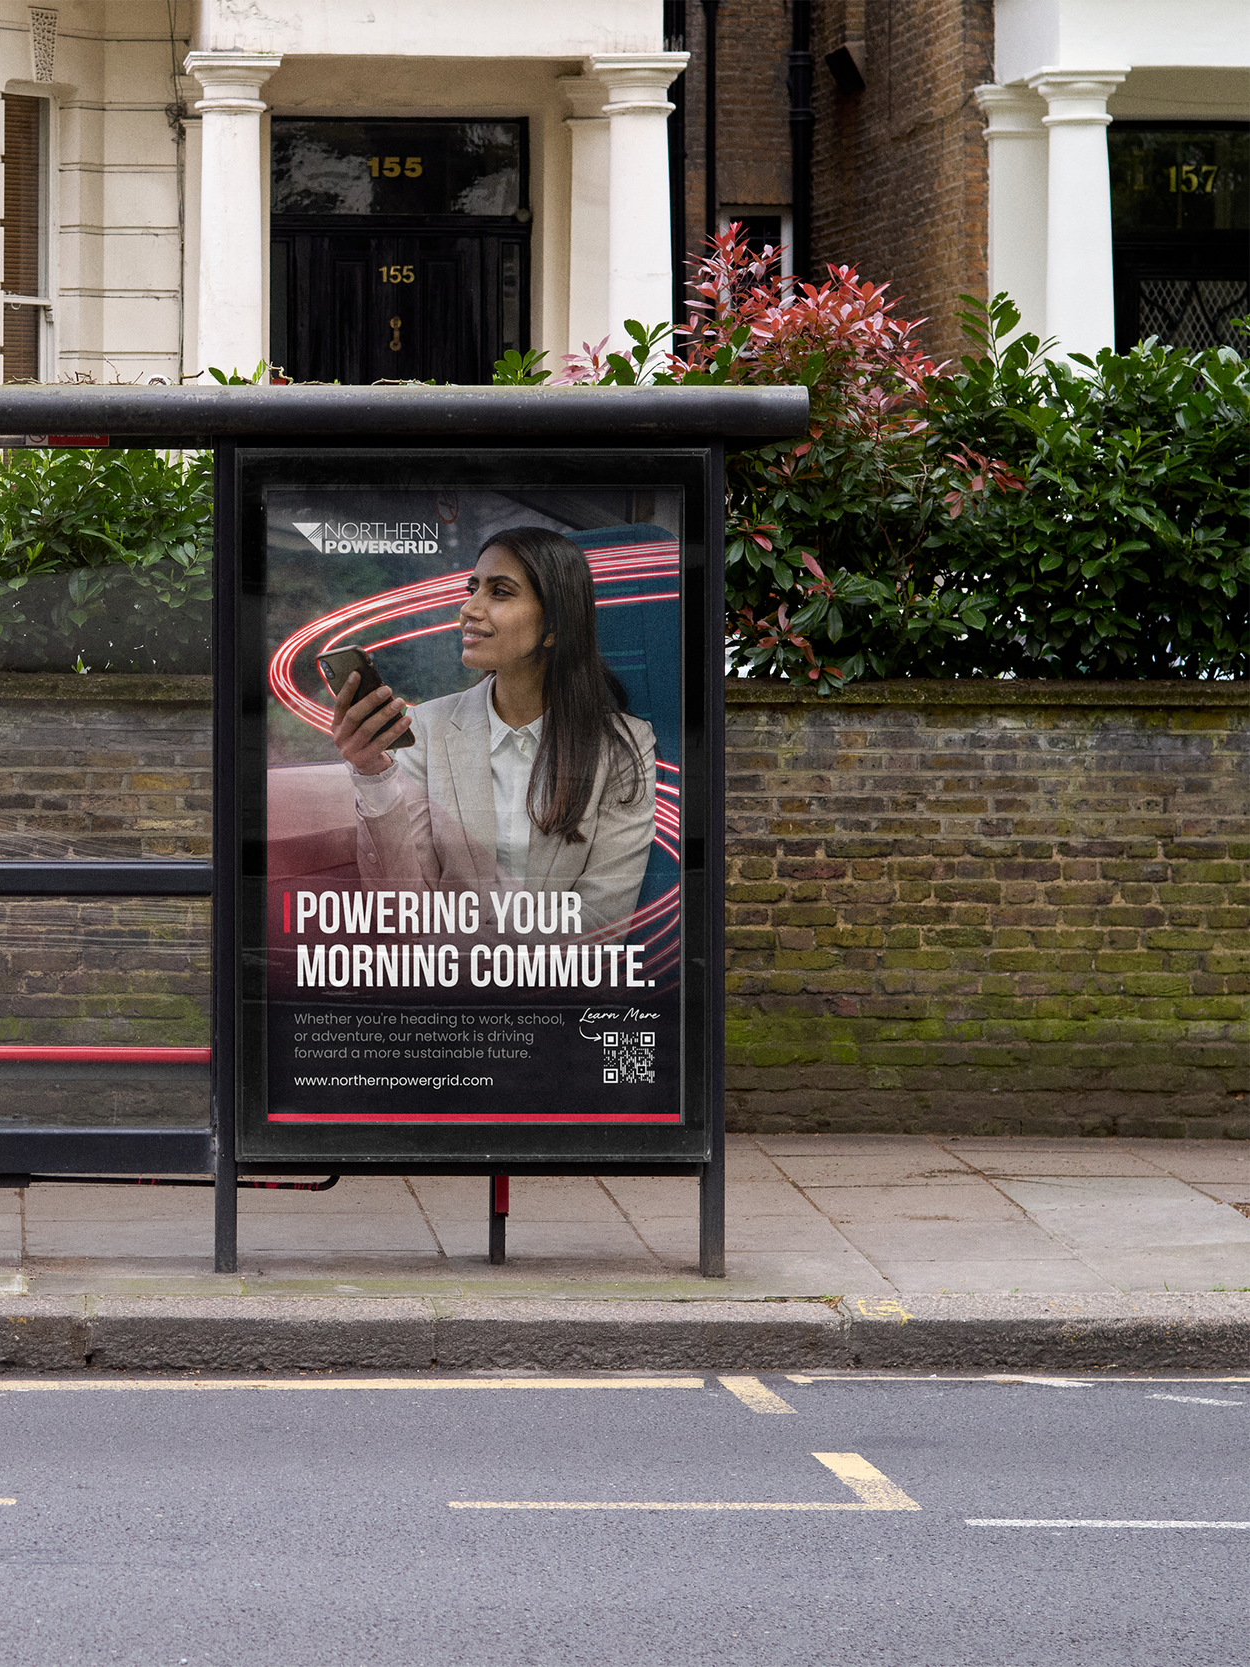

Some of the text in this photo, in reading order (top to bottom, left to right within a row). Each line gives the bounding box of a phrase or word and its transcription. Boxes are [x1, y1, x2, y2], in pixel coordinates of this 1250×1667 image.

[367, 157, 424, 178] 155
[1168, 165, 1219, 193] 157
[378, 265, 415, 284] 155
[325, 522, 439, 540] NORTHERN
[296, 890, 583, 934] POWERING YOUR
[296, 944, 656, 988] MORNING COMMUTE.
[293, 1013, 566, 1028] Whether you're heading to work, school,
[579, 1007, 661, 1024] Learn More
[293, 1030, 534, 1045] or adventure, our network is driving
[293, 1047, 531, 1059] forward a more sustainable future.
[293, 1075, 494, 1090] www.northernpowergrid.com
